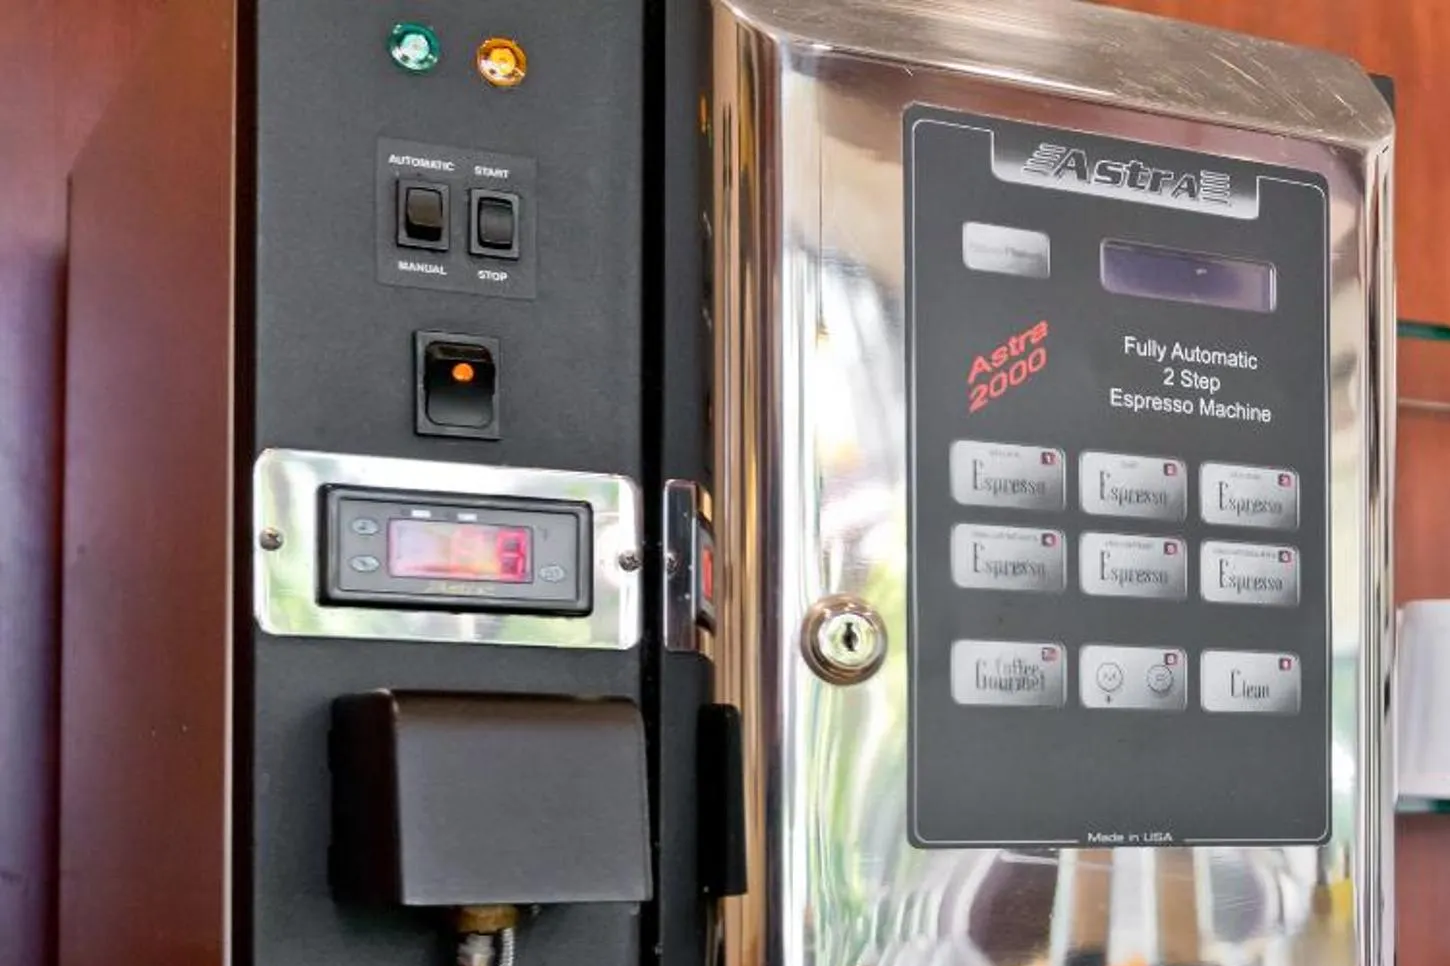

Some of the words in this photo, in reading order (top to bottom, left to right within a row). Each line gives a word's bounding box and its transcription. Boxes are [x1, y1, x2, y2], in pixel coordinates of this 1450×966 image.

[388, 154, 456, 172] AUTOMATIC
[474, 165, 510, 179] START
[397, 260, 448, 276] MANUAL
[477, 269, 508, 282] STOP
[967, 319, 1049, 385] Astra
[1123, 335, 1167, 363] Fully
[1170, 341, 1258, 370] Automatic
[968, 347, 1048, 414] 2000
[1162, 366, 1175, 386] 2
[1179, 368, 1221, 395] Step
[1109, 387, 1194, 415] Espresso
[1199, 397, 1272, 423] Machine
[972, 458, 1047, 497] Espresso
[1099, 469, 1169, 506] Espresso
[1218, 480, 1284, 517] Espresso
[972, 541, 1047, 579] Espresso
[1099, 550, 1169, 587] Espresso
[1218, 557, 1284, 594] Espresso
[1230, 669, 1270, 699] Clean
[1087, 832, 1124, 843] Made
[1128, 833, 1140, 842] in
[1143, 831, 1173, 842] USA
